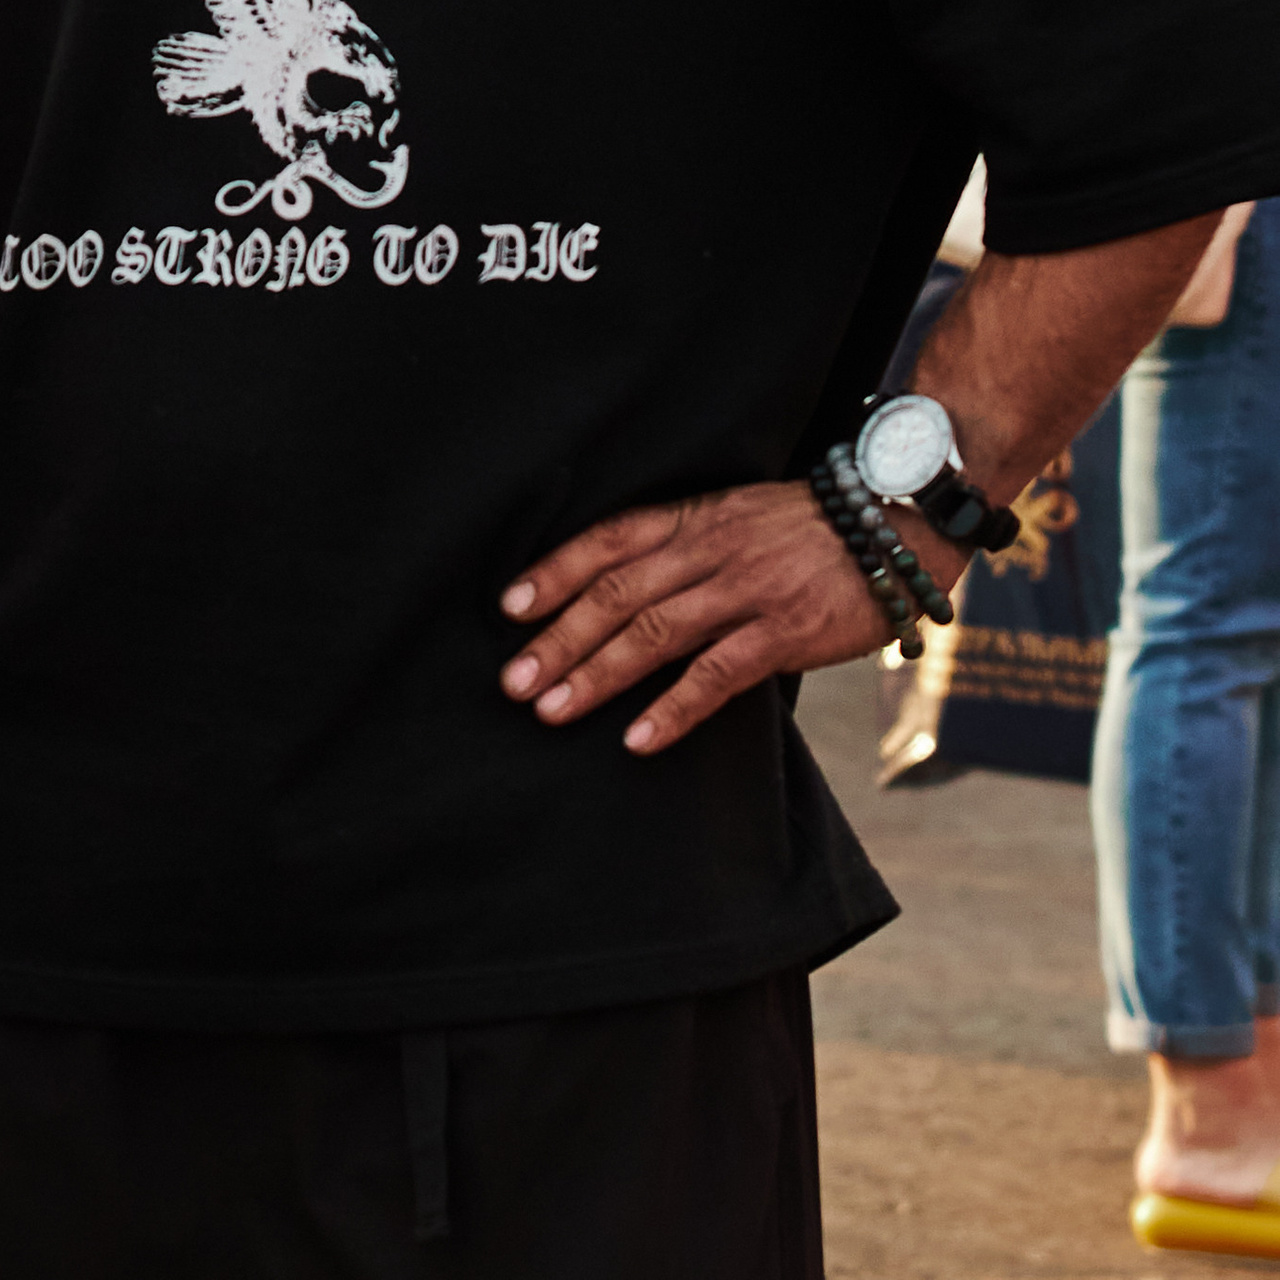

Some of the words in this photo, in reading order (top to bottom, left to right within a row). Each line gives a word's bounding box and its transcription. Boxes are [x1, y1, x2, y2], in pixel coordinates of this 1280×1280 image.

[110, 225, 351, 292] STRONG
[372, 223, 460, 286] TO
[477, 221, 602, 284] DIE
